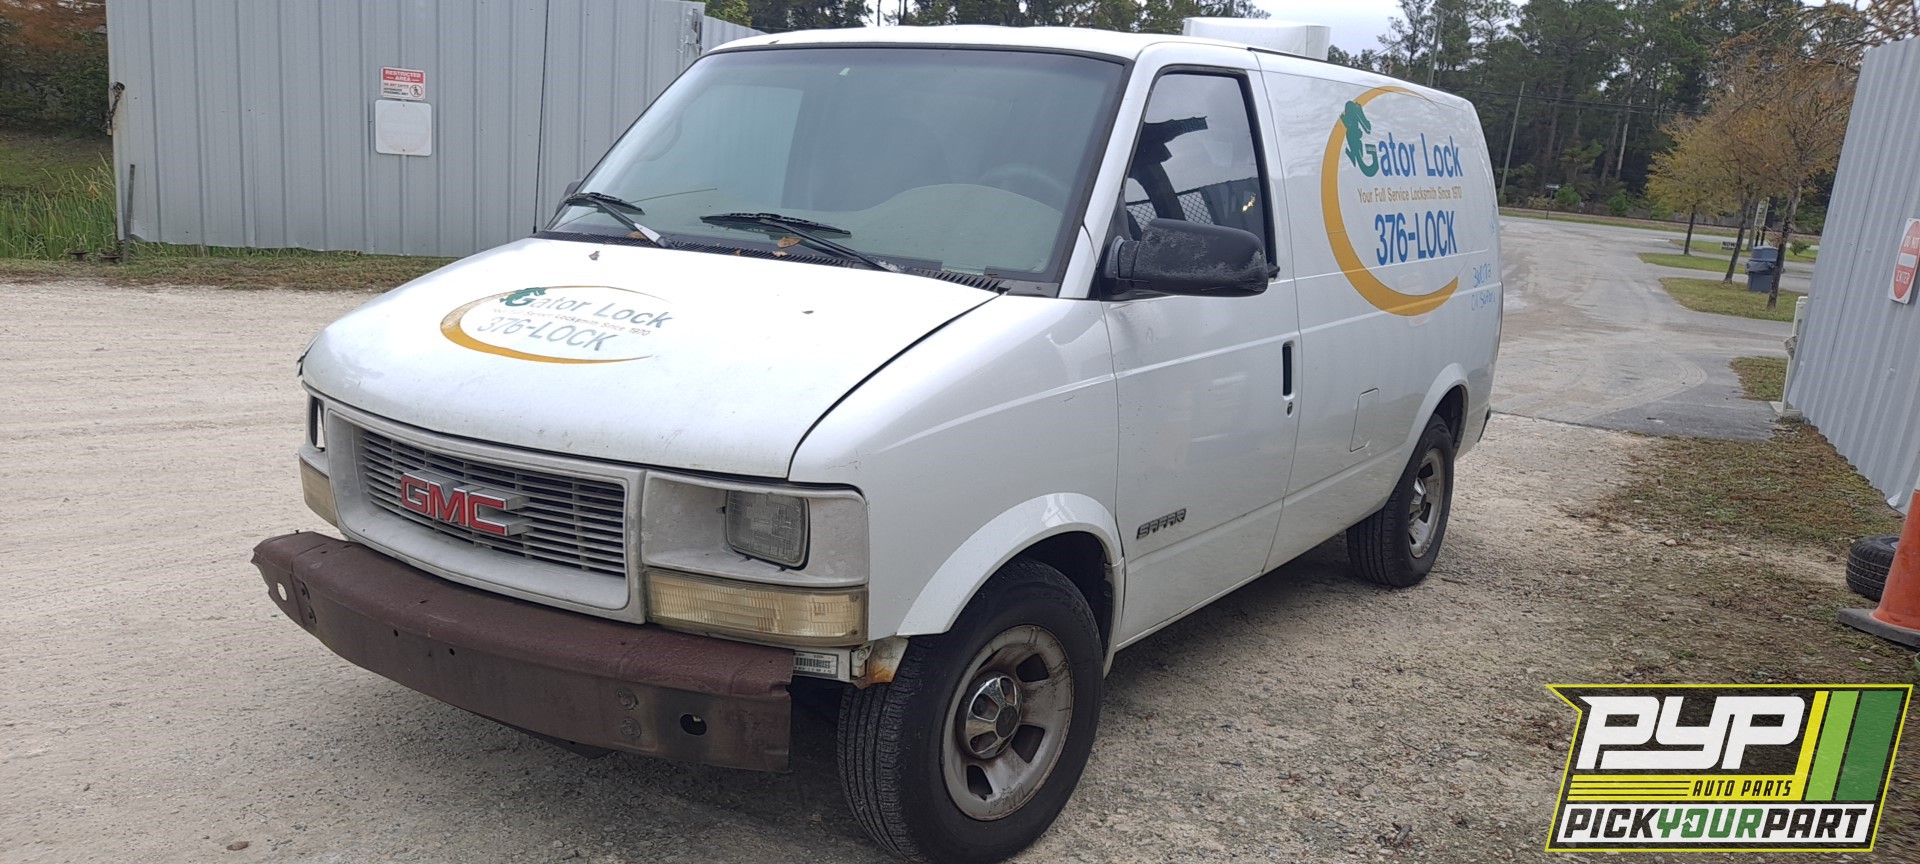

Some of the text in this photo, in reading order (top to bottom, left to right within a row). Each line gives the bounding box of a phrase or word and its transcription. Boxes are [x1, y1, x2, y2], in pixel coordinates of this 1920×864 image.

[385, 69, 421, 78] RESTRICTED
[1348, 131, 1463, 177] Gator Lock
[1357, 187, 1373, 204] Your
[1374, 187, 1386, 203] Full
[1387, 186, 1410, 202] Service
[1410, 186, 1437, 201] Locksmith
[1438, 186, 1451, 200] Since
[1374, 210, 1458, 266] 376-LOCK
[503, 290, 673, 328] Gator Lock
[477, 316, 619, 351] 376-LOCK
[400, 472, 509, 536] GMC
[1136, 508, 1187, 540] SAFARI
